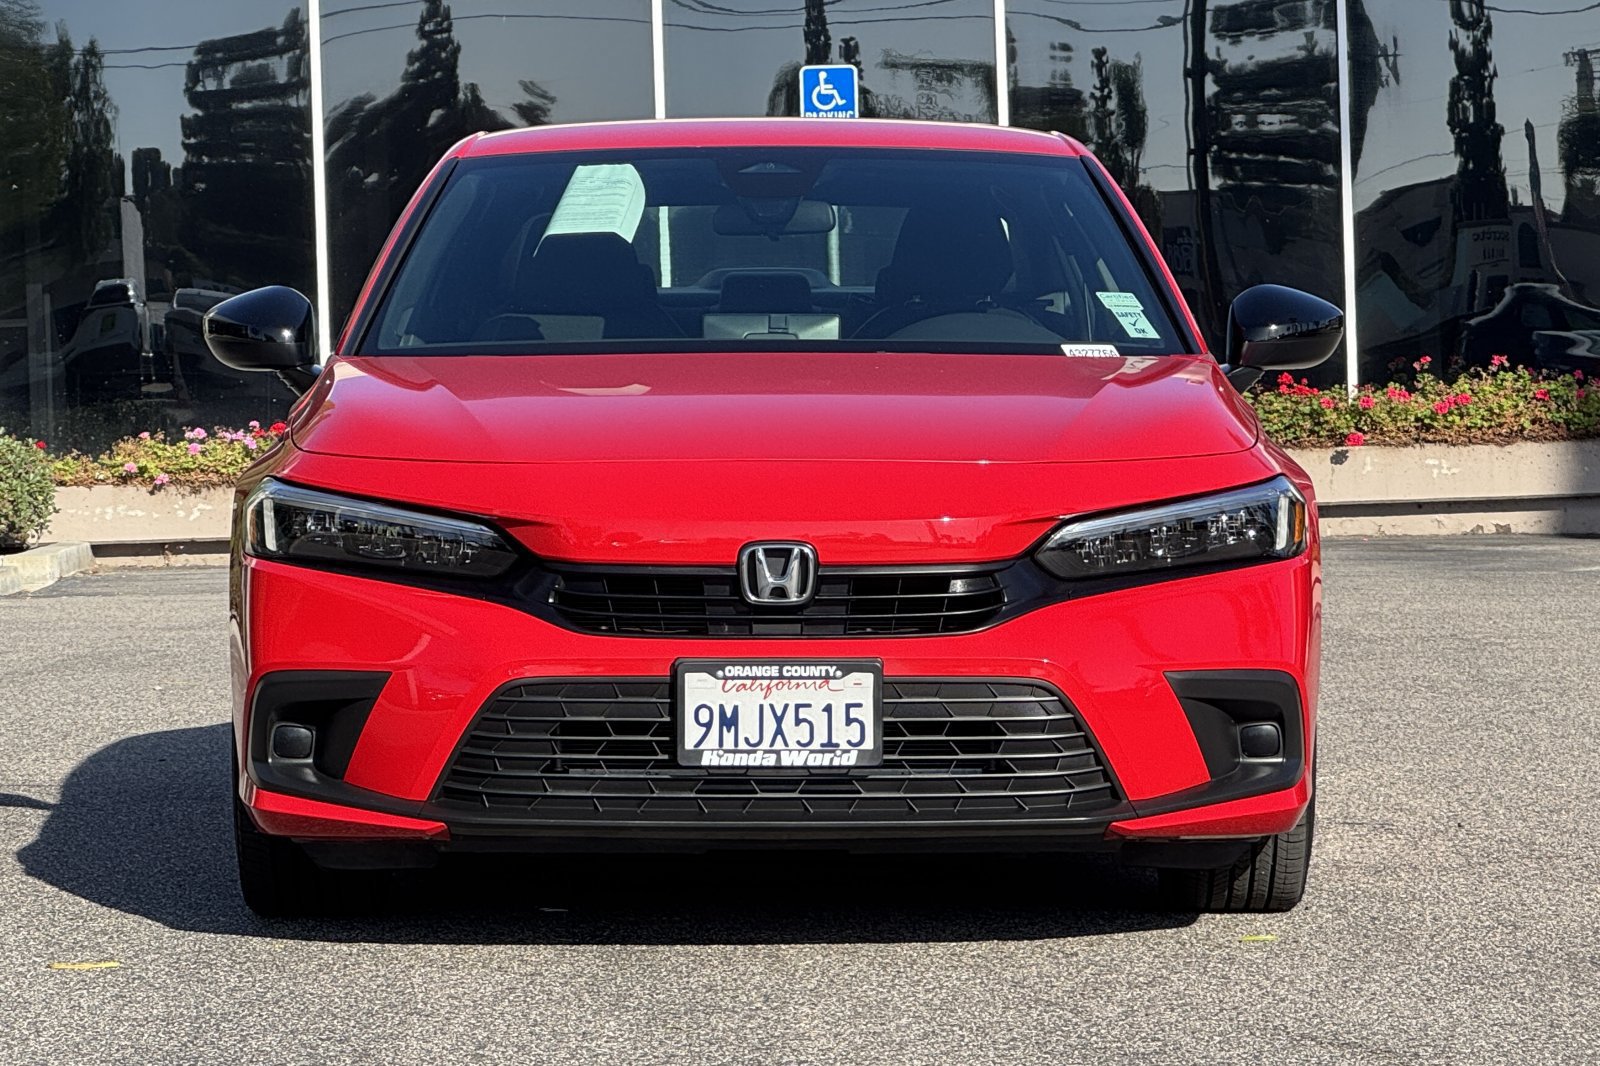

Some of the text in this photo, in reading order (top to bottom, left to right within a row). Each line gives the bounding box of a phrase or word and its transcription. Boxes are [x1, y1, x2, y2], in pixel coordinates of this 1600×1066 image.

[1115, 311, 1143, 319] SAFETY
[1134, 327, 1148, 335] OK
[724, 665, 837, 677] ORANGE COUNTY
[721, 678, 844, 700] California
[693, 703, 866, 749] 9MJX515
[701, 750, 859, 766] Honda World
